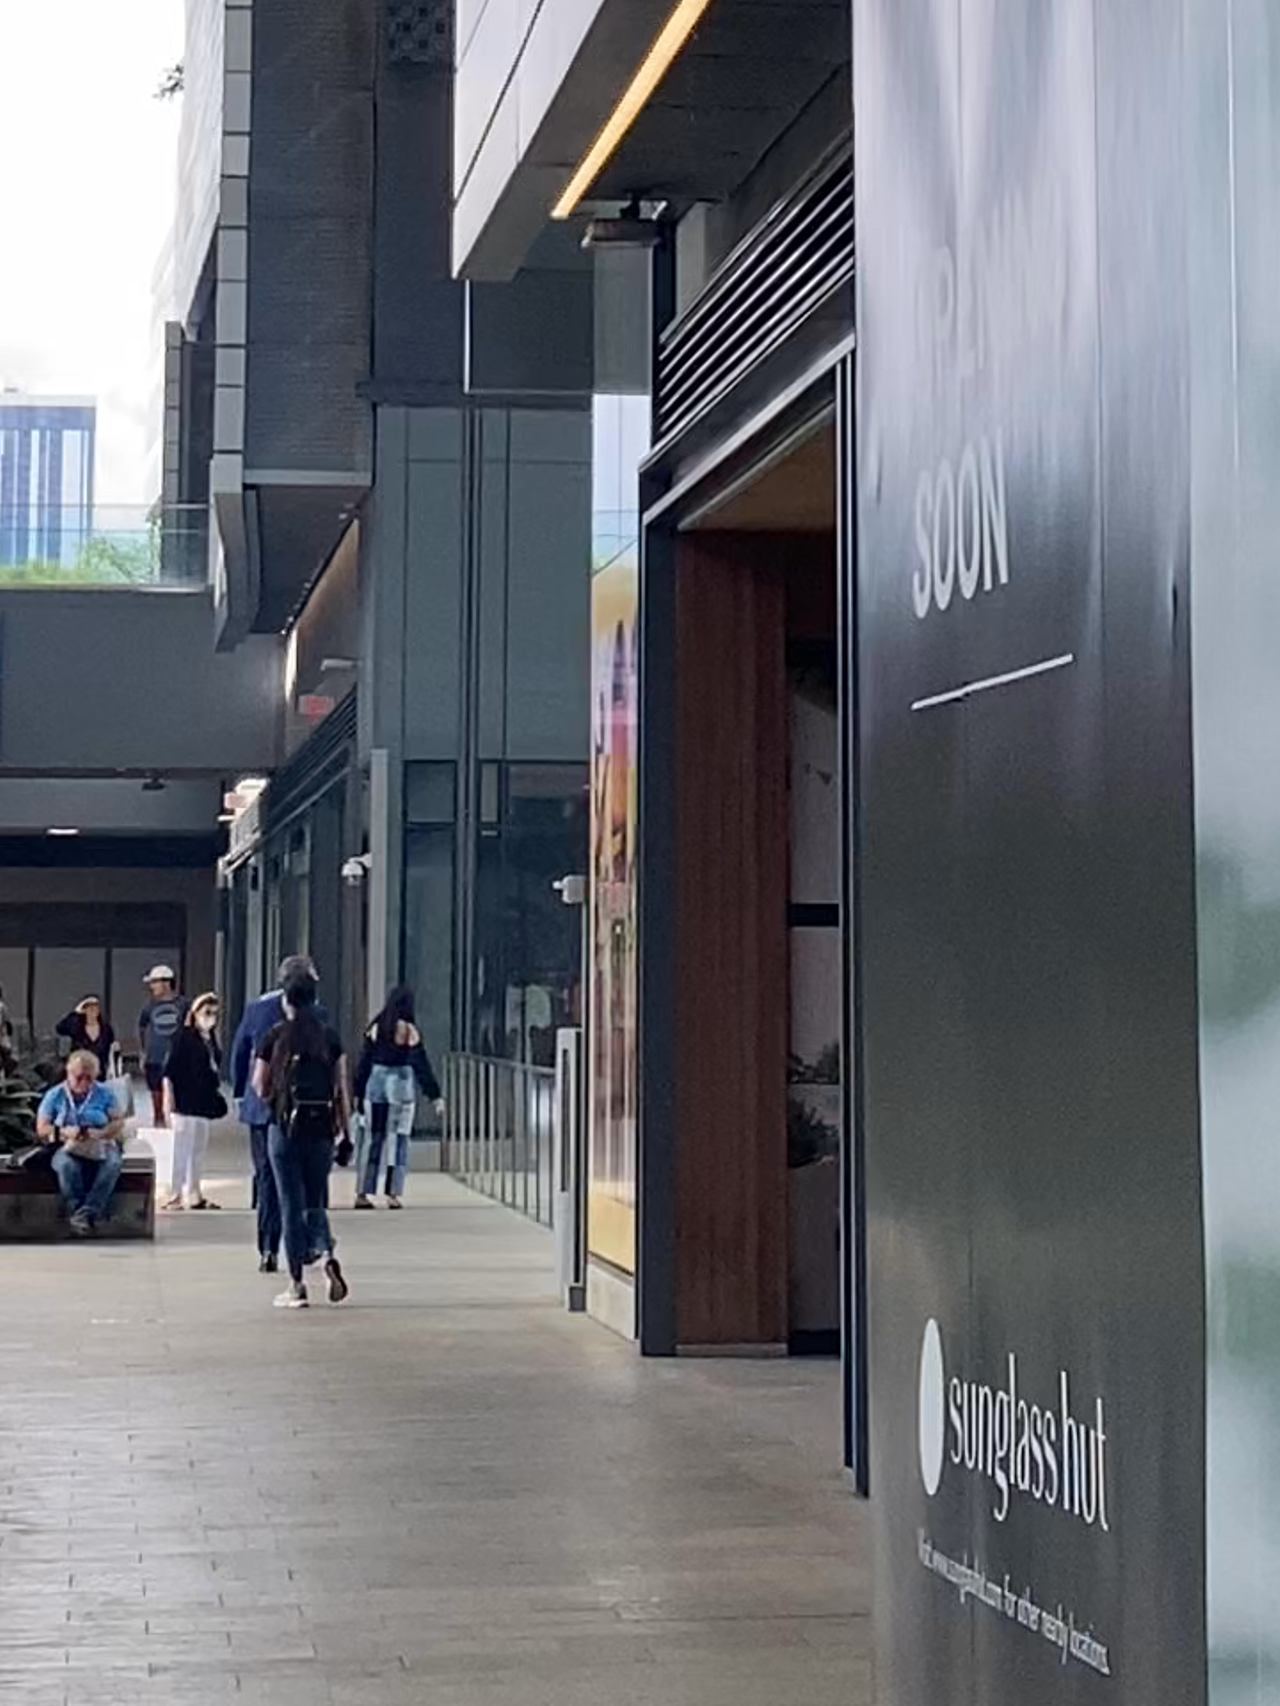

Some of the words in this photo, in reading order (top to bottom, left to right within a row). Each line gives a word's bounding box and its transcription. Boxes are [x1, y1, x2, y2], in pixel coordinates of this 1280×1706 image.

[913, 426, 1008, 619] SOON
[949, 1352, 1058, 1522] sunglass
[1061, 1370, 1108, 1532] hut
